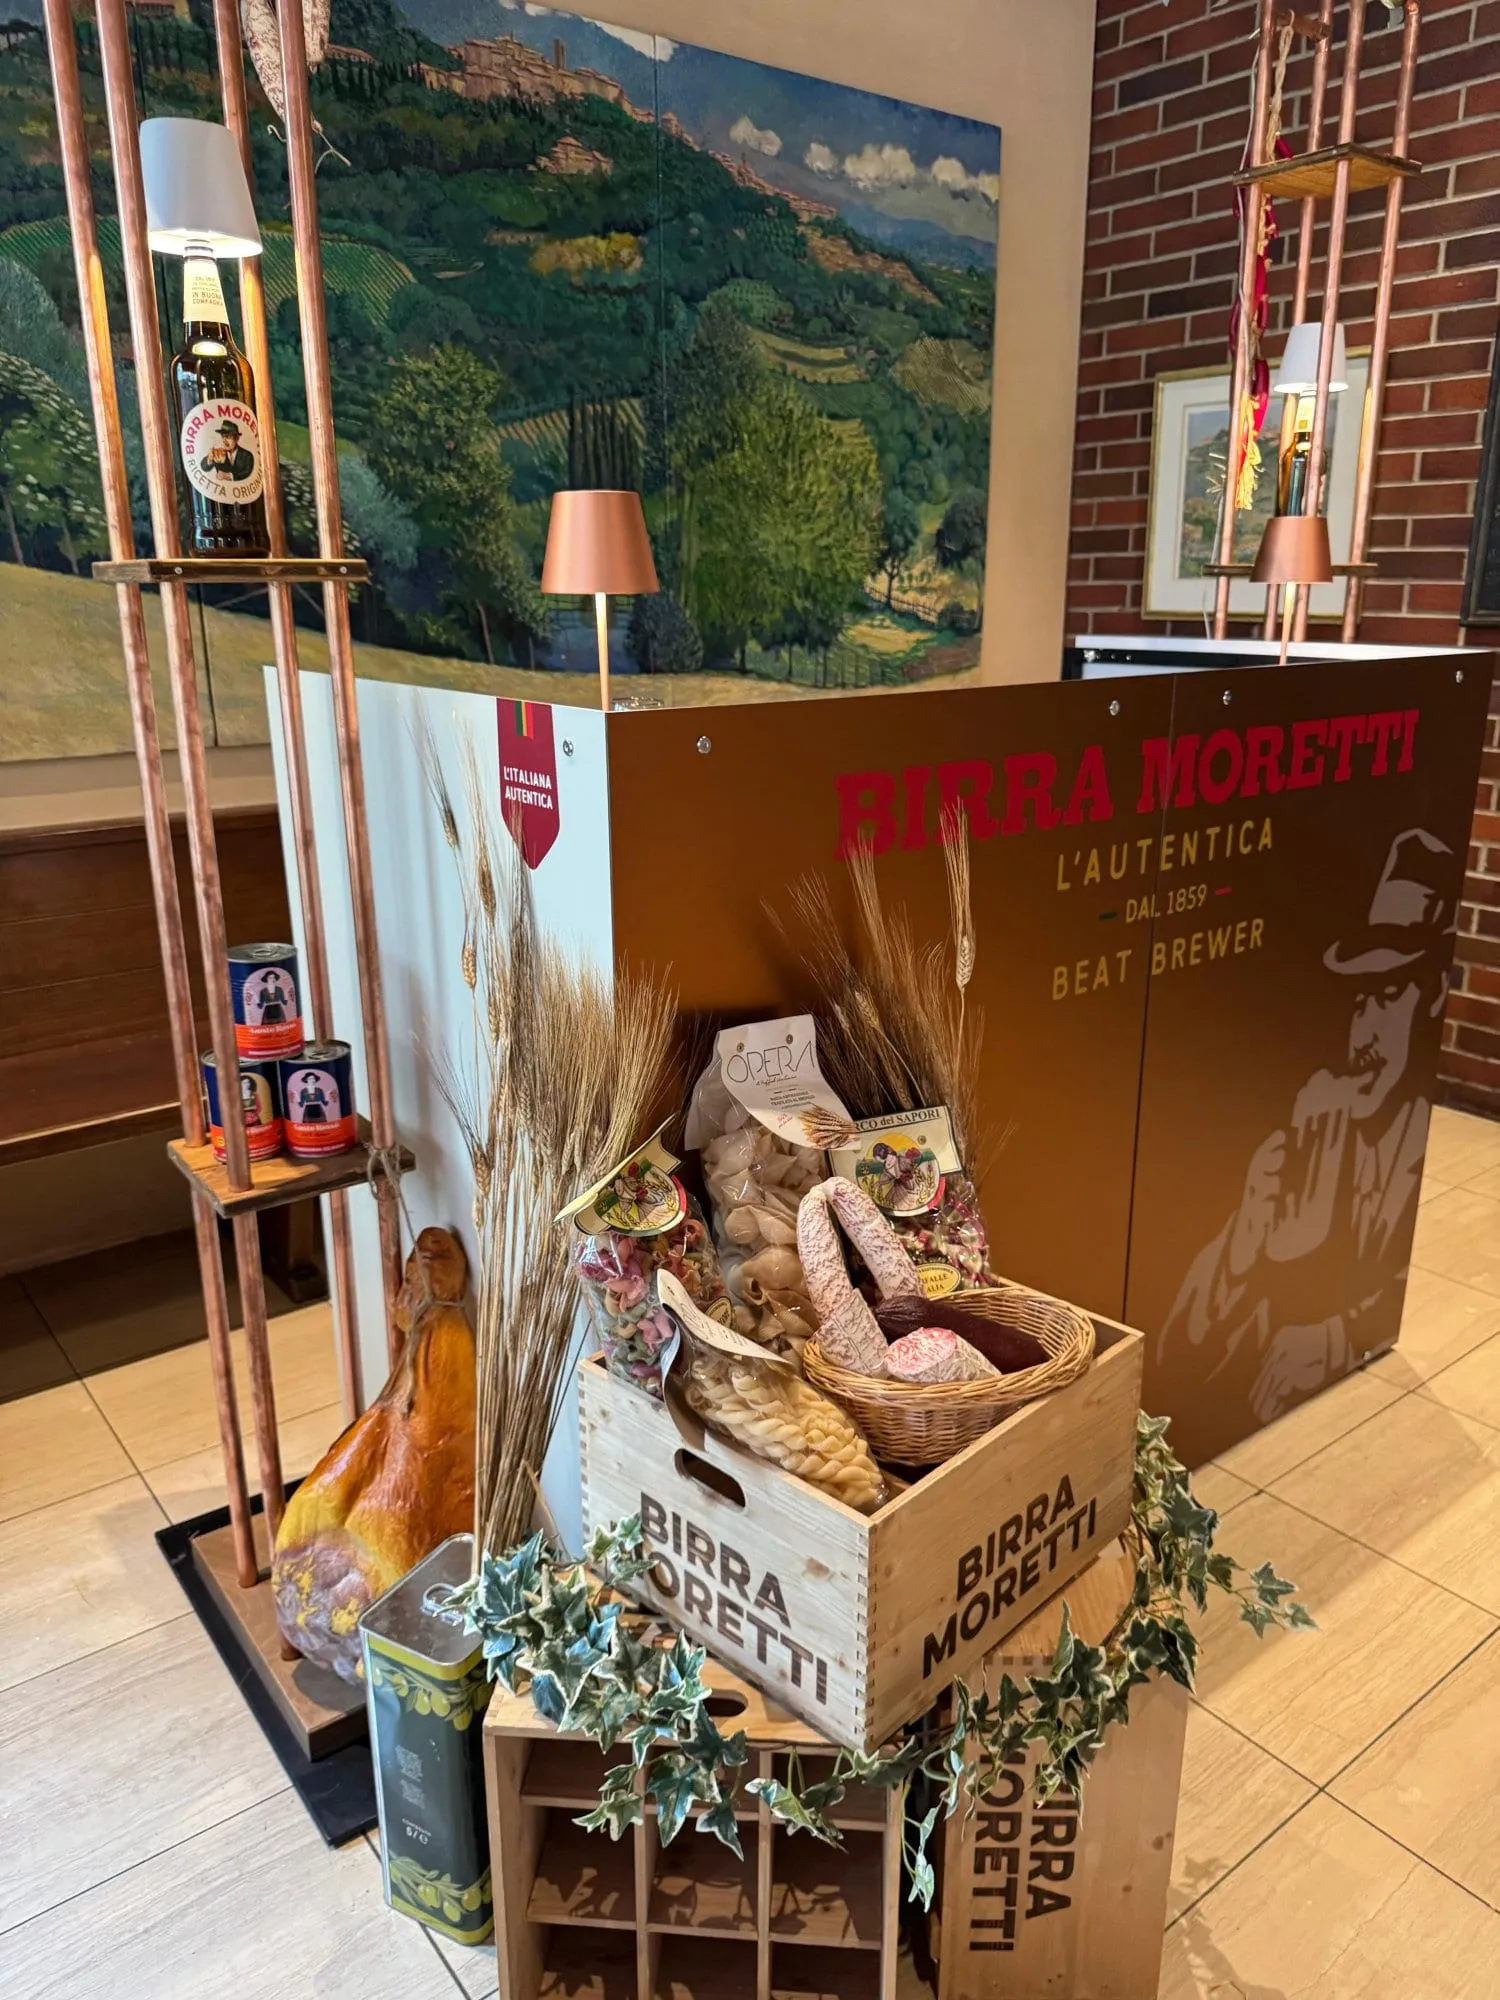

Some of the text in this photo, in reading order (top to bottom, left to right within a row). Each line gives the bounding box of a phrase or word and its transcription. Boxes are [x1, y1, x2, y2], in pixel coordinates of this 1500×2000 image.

[185, 408, 215, 455] BIRRA
[188, 458, 227, 498] RICETTA
[503, 766, 552, 790] L'ITALIANA
[505, 785, 553, 810] AUTENTICA
[833, 708, 1420, 862] BIRRA MORETTI
[1056, 817, 1273, 891] L'AUTENTICA
[1125, 884, 1207, 923] DAL 1859
[1052, 918, 1264, 1001] BEAT BREWER
[727, 1040, 815, 1083] OPERA
[896, 1108, 941, 1124] SAPORI
[640, 1490, 791, 1630] BIRRA
[956, 1474, 1075, 1602] BIRRA
[618, 1541, 828, 1705] ORETTI
[922, 1497, 1097, 1680] MORETTI
[969, 1752, 1026, 1951] ORETTI
